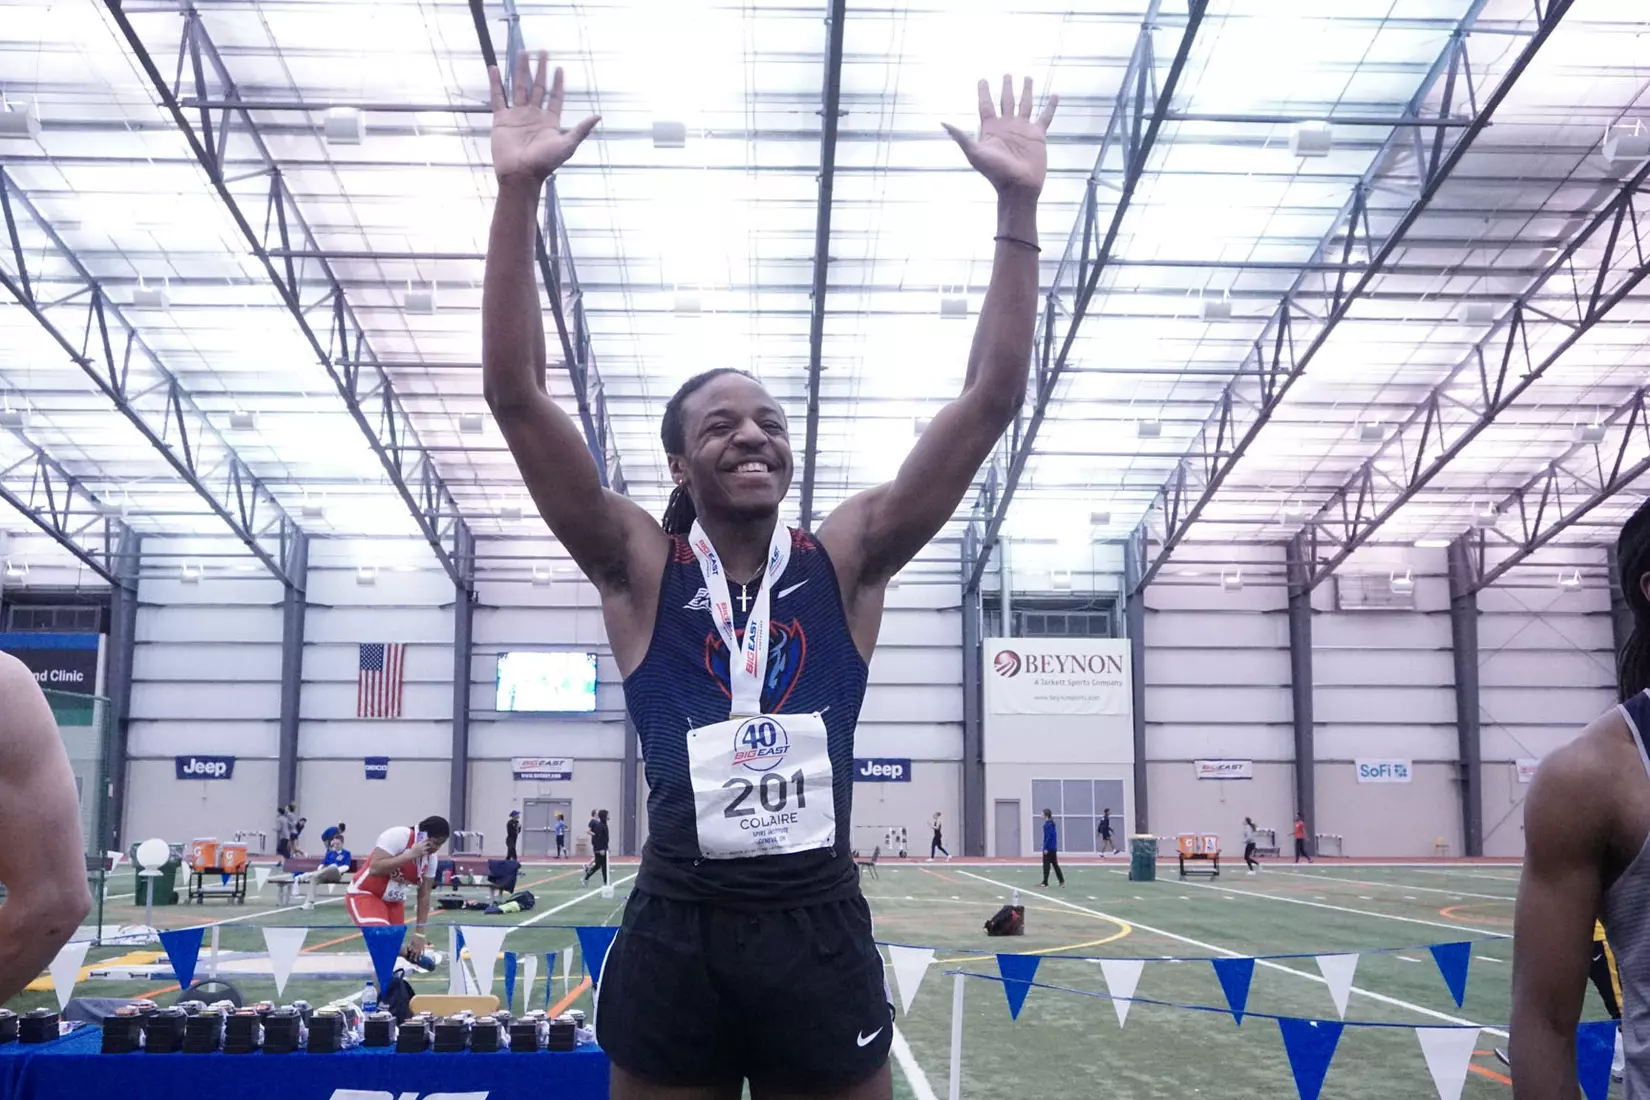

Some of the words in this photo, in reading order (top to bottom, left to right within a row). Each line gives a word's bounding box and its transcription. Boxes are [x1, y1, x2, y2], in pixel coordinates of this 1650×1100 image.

[748, 620, 757, 652] EAST
[746, 650, 755, 674] BIG
[1024, 654, 1123, 674] BEYNON
[50, 669, 84, 682] Clinic
[1067, 678, 1090, 688] Sports
[1092, 678, 1123, 688] Company
[742, 721, 777, 749] 40
[735, 749, 757, 760] BIG
[757, 745, 791, 757] EAST
[183, 758, 227, 777] Jeep
[860, 760, 903, 779] Jeep
[1360, 763, 1391, 777] SoFi
[722, 768, 806, 818] 201
[740, 812, 798, 830] COLAIRE
